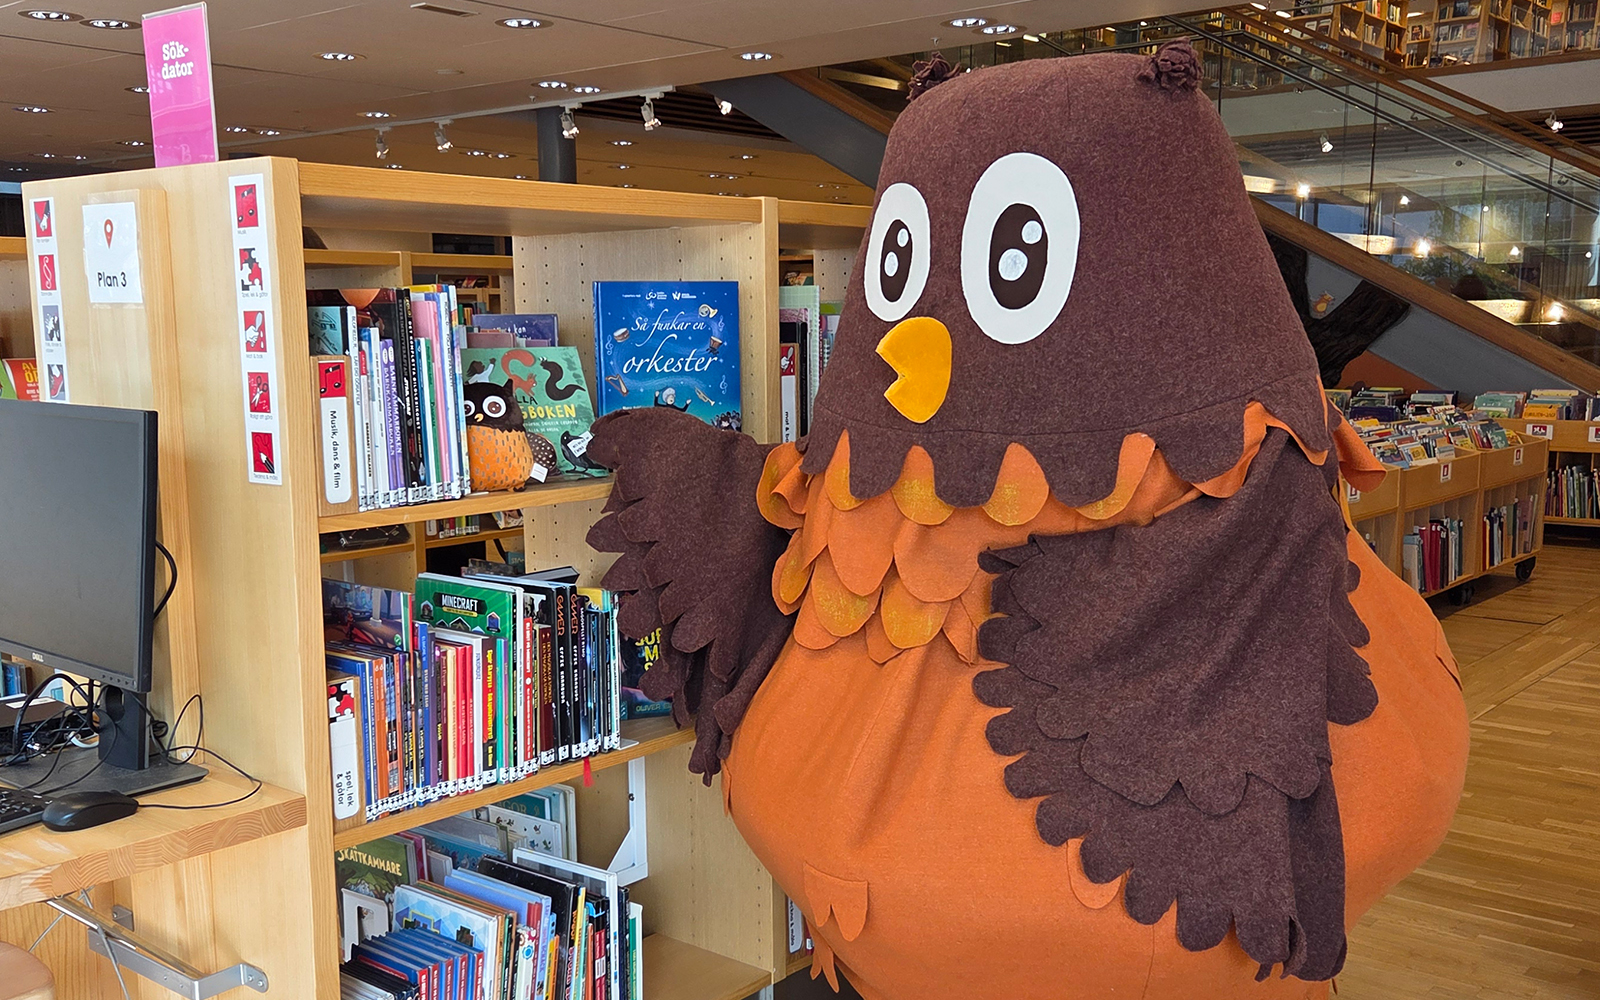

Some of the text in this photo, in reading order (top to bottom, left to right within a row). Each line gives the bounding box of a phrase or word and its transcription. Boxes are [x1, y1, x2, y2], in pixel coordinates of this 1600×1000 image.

[162, 41, 189, 60] Sök-
[162, 61, 193, 79] dator
[97, 272, 127, 287] Plan 3
[631, 308, 706, 348] Så funkar en
[622, 333, 717, 374] orkester
[384, 367, 396, 456] BARNKAMMARBOKEN
[390, 365, 402, 454] BARNKAMMARBOKEN
[329, 410, 338, 439] Musik,
[332, 441, 340, 461] dans
[333, 472, 341, 489] film
[441, 594, 478, 611] MINECRAFT
[557, 595, 565, 636] GAMER
[32, 652, 44, 662] DELL
[345, 770, 354, 792] spel,
[337, 848, 402, 877] SKATTKAMMARE
